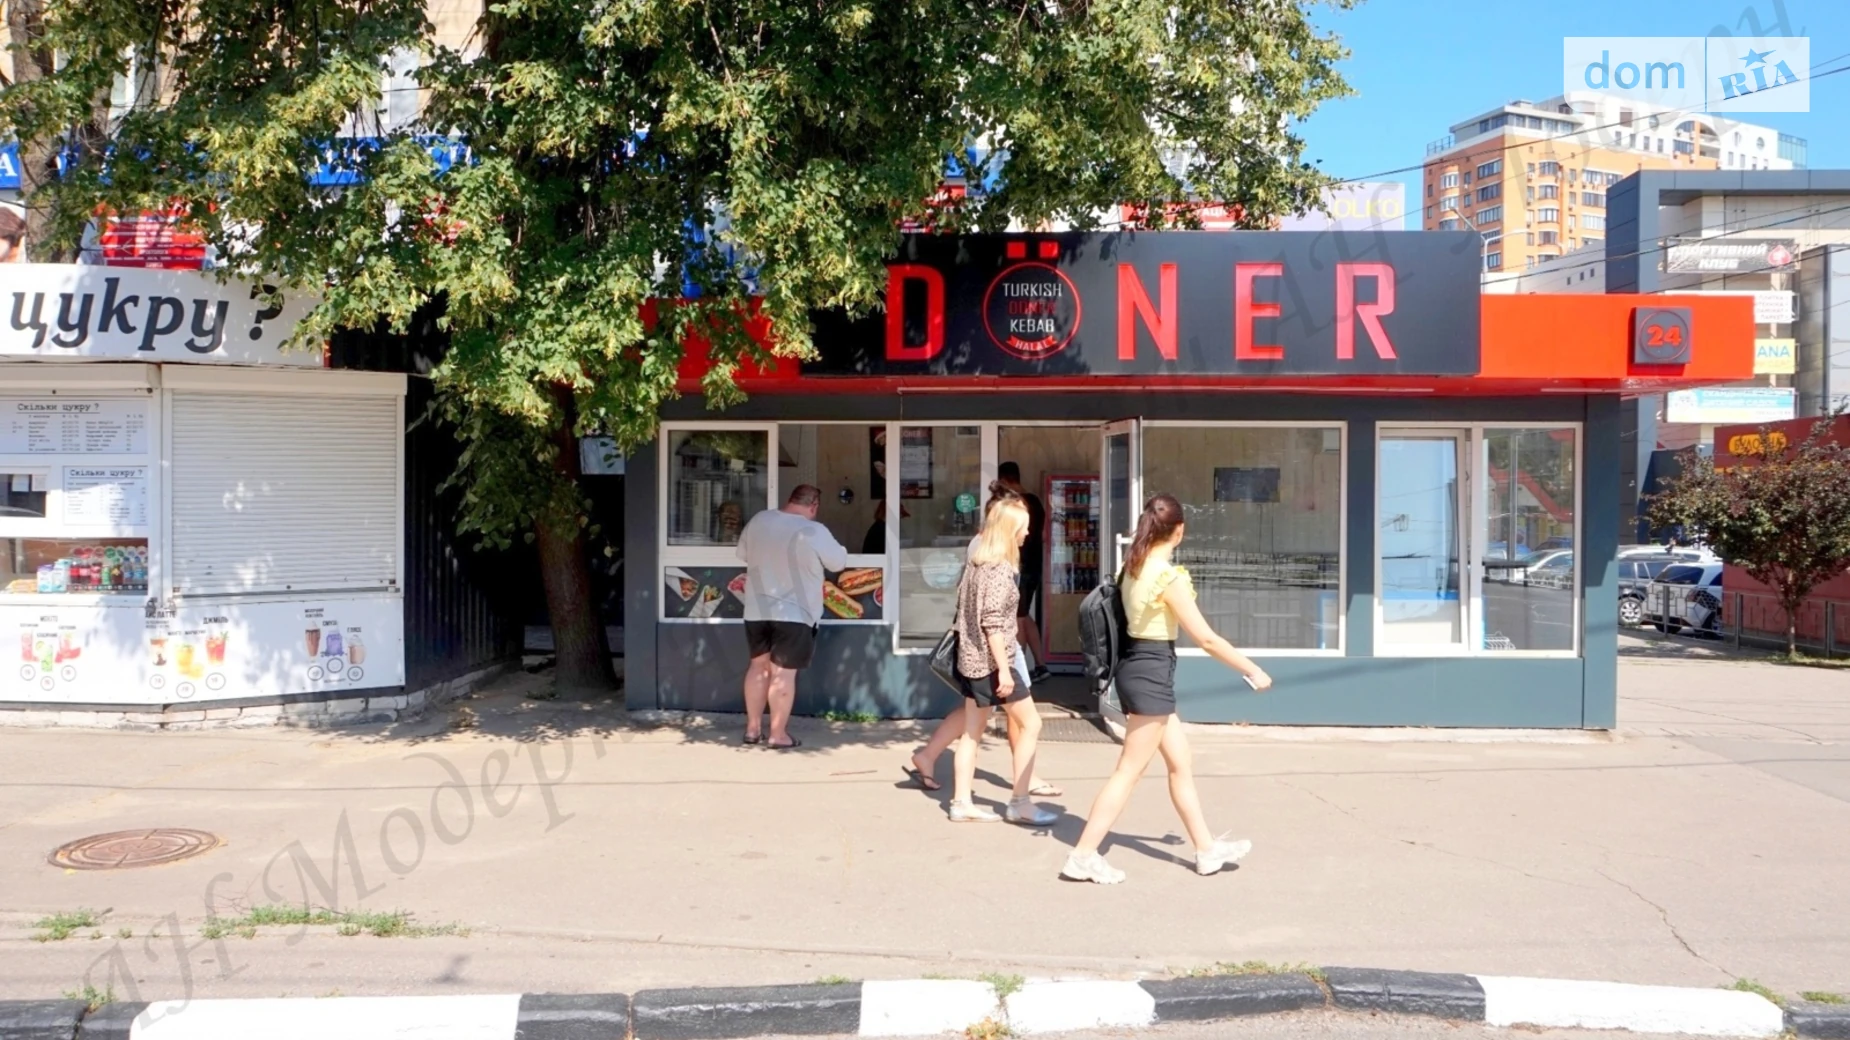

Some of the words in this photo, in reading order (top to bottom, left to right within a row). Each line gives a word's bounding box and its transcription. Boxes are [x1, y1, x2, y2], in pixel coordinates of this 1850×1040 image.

[1698, 258, 1739, 270] КЛУБ
[1003, 283, 1062, 297] TURKISH
[10, 277, 229, 354] цукру
[249, 284, 285, 341] ?
[1010, 319, 1055, 333] KEBAB
[1646, 324, 1683, 347] 24
[1014, 339, 1051, 351] HALAL
[17, 403, 57, 411] Скільки
[62, 403, 91, 413] цукру
